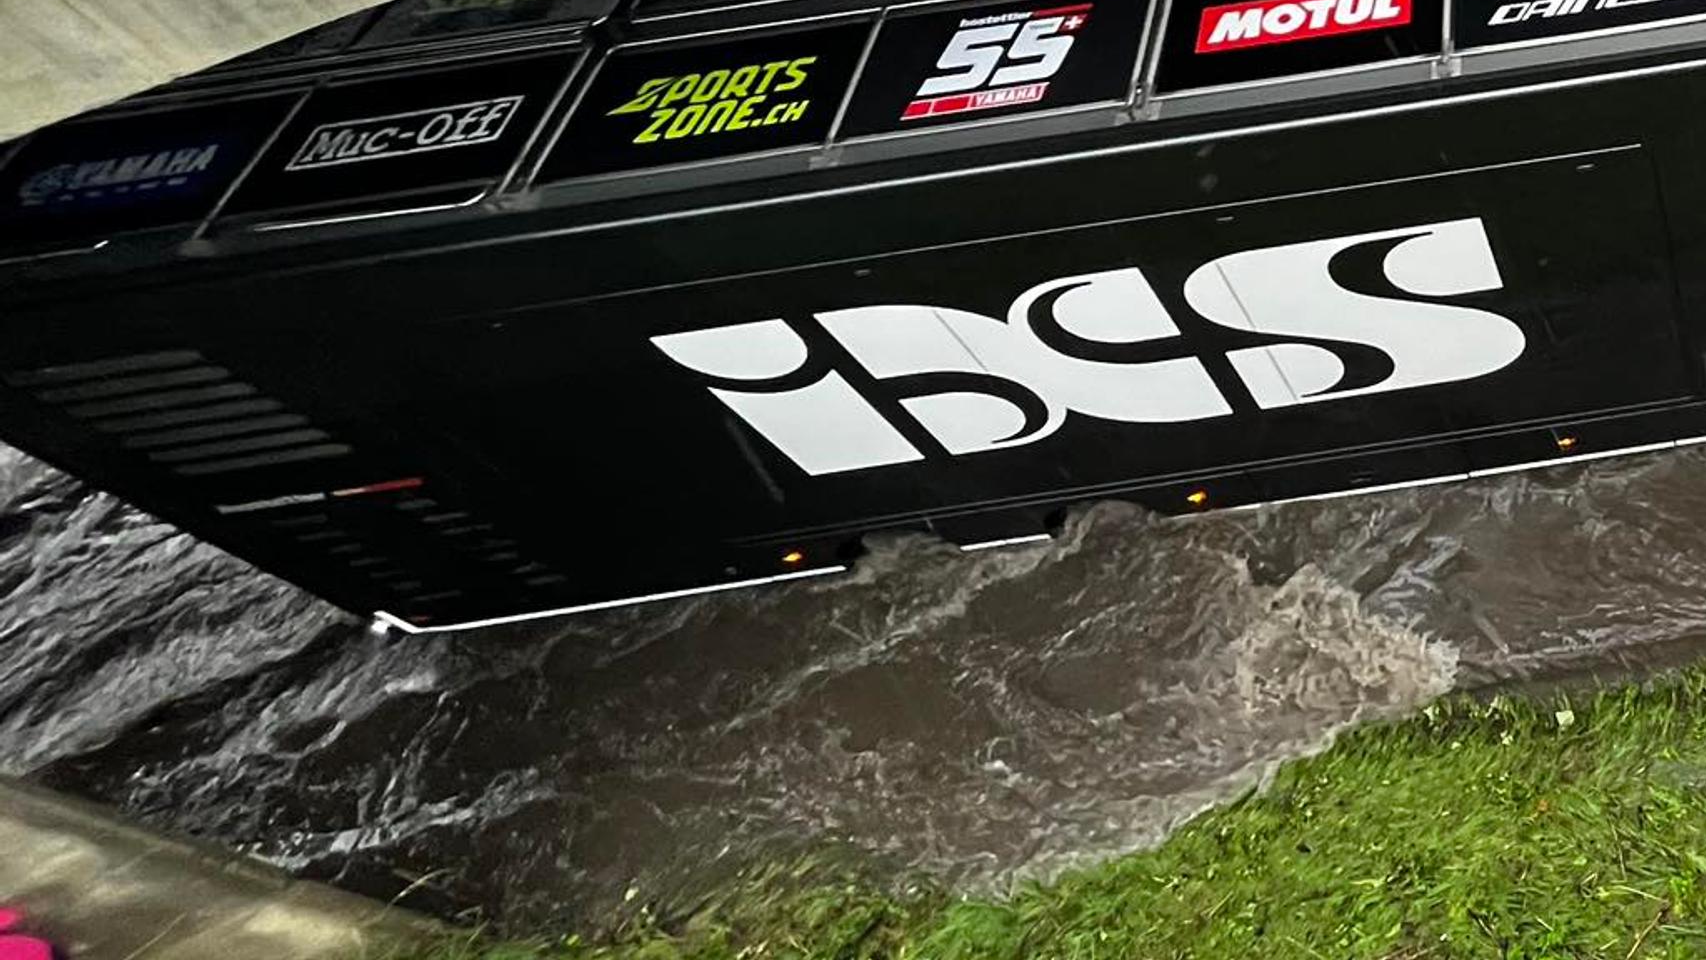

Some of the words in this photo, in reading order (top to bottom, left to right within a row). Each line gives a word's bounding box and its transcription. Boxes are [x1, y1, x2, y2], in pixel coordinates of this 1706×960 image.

[915, 16, 1076, 97] 55
[605, 55, 818, 117] SPORTS
[975, 84, 1038, 106] YAMAHA
[298, 100, 513, 164] Muc-Off
[632, 95, 811, 144] ZONE.CH
[74, 143, 219, 191] YAMAHA
